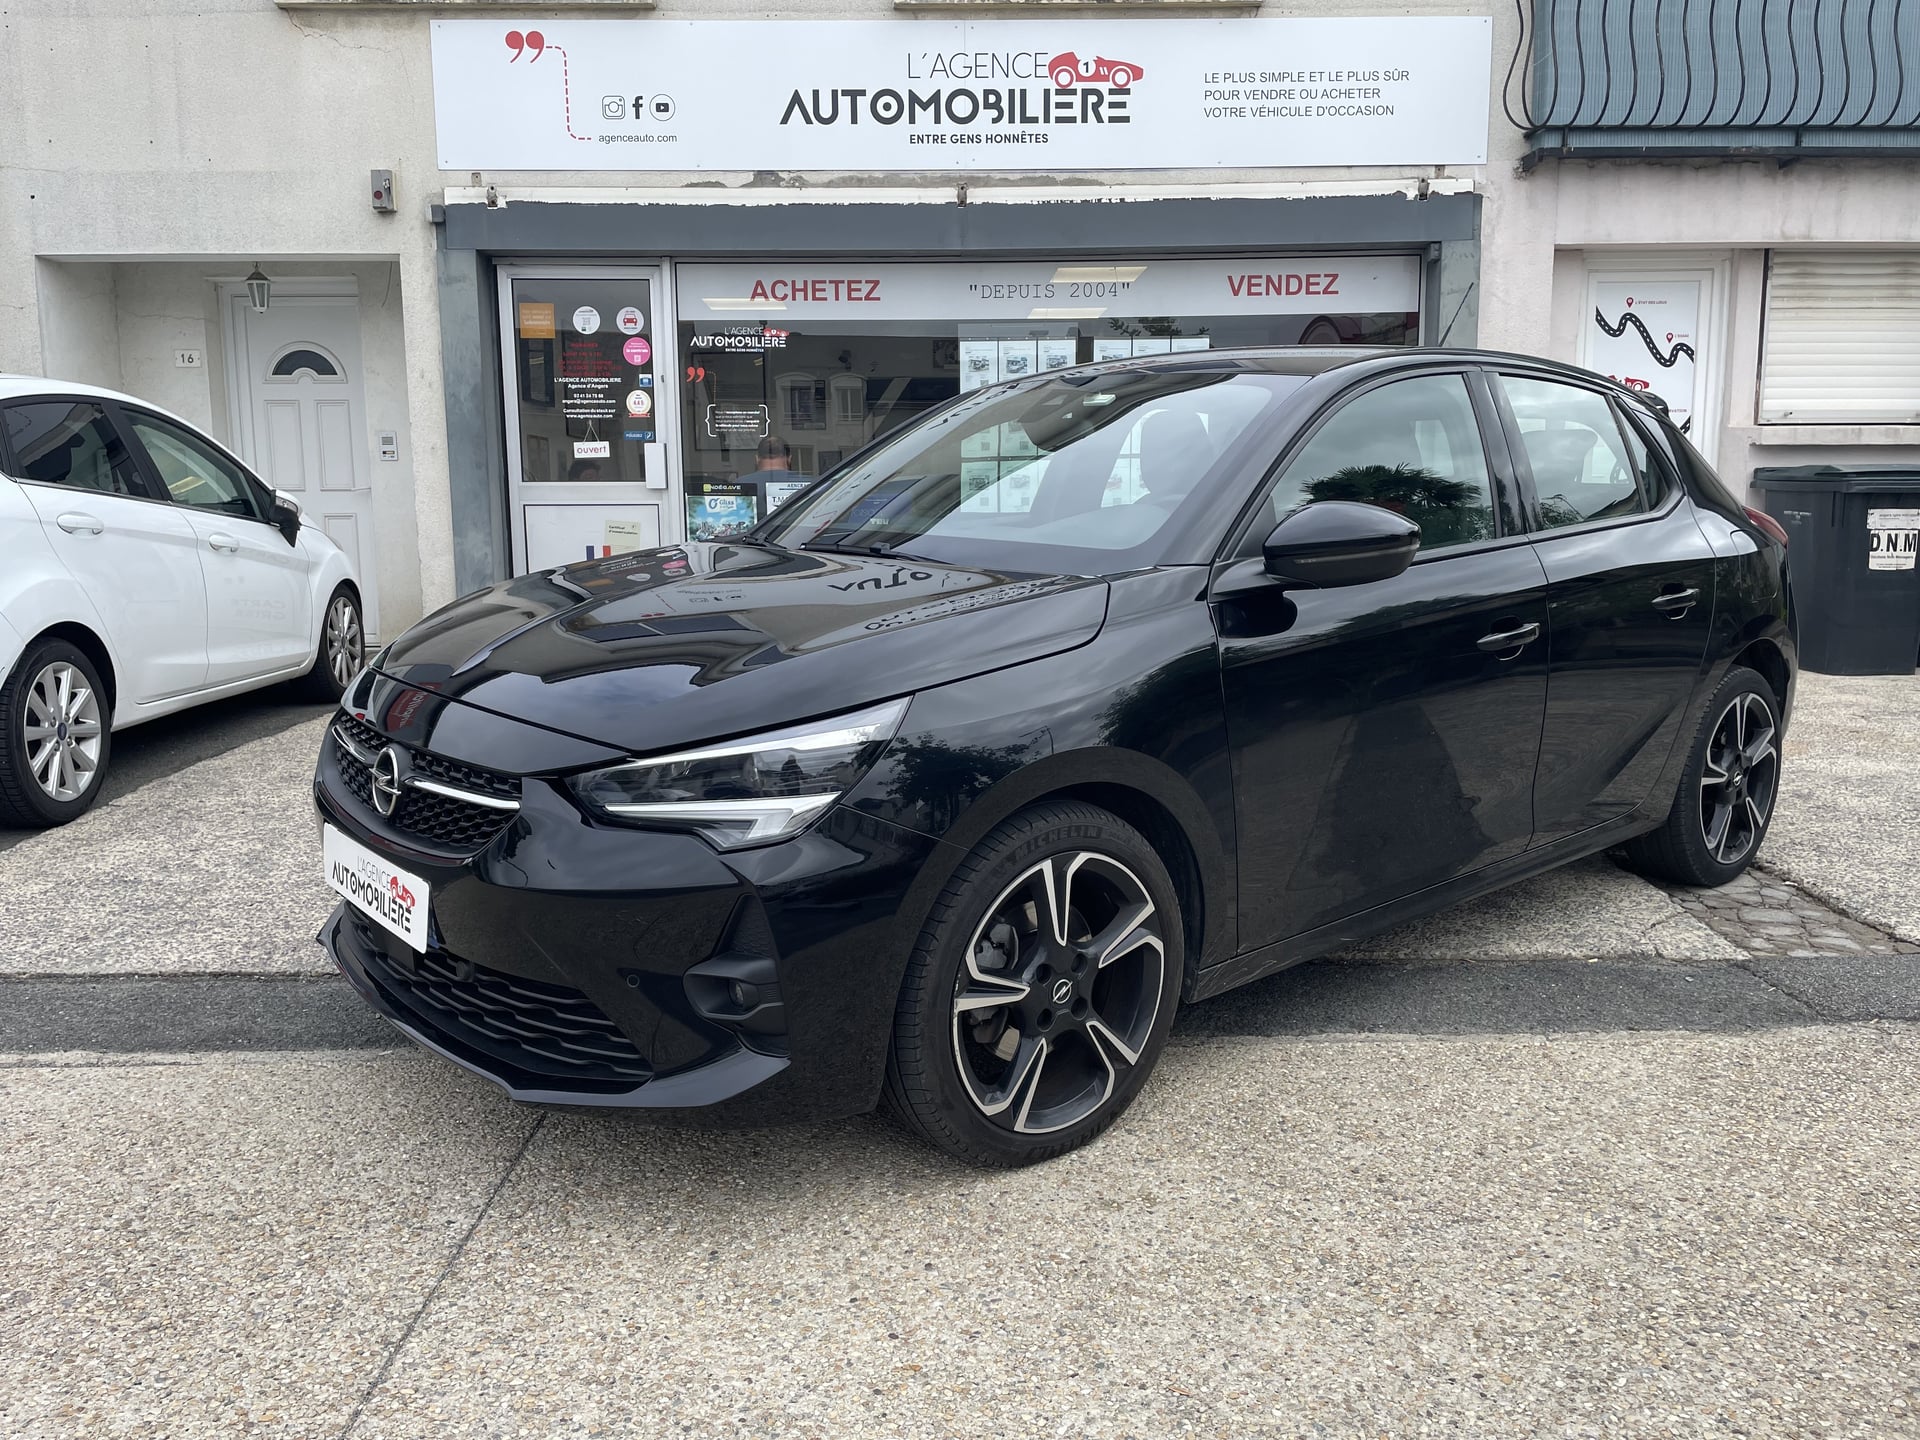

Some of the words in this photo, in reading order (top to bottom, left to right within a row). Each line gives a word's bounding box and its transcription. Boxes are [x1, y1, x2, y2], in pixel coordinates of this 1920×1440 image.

[907, 52, 1049, 79] L'AGENCE
[1204, 72, 1220, 84] LE
[1223, 72, 1256, 84] PLUS
[1259, 71, 1305, 83] SIMPLE
[1309, 71, 1325, 83] ET
[1328, 71, 1344, 82] LE
[1347, 70, 1380, 82] PLUS
[1383, 68, 1410, 82] SÛR
[1204, 90, 1240, 101] POUR
[1244, 89, 1296, 101] VENDRE
[1299, 88, 1319, 100] OU
[1320, 87, 1381, 99] ACHETER
[1203, 107, 1247, 118] VOTRE
[1250, 104, 1313, 118] VÉHICULE
[1316, 105, 1395, 118] D'OCCASION
[598, 133, 678, 145] agenceauto.com
[909, 134, 947, 145] ENTRE
[950, 134, 982, 145] GENS
[985, 130, 1049, 145] HONNÊTES
[750, 279, 881, 302] ACHETEZ
[1227, 273, 1339, 297] VENDEZ
[724, 326, 764, 335] L'AGENCE
[180, 353, 194, 364] 16
[576, 445, 607, 455] ouvert
